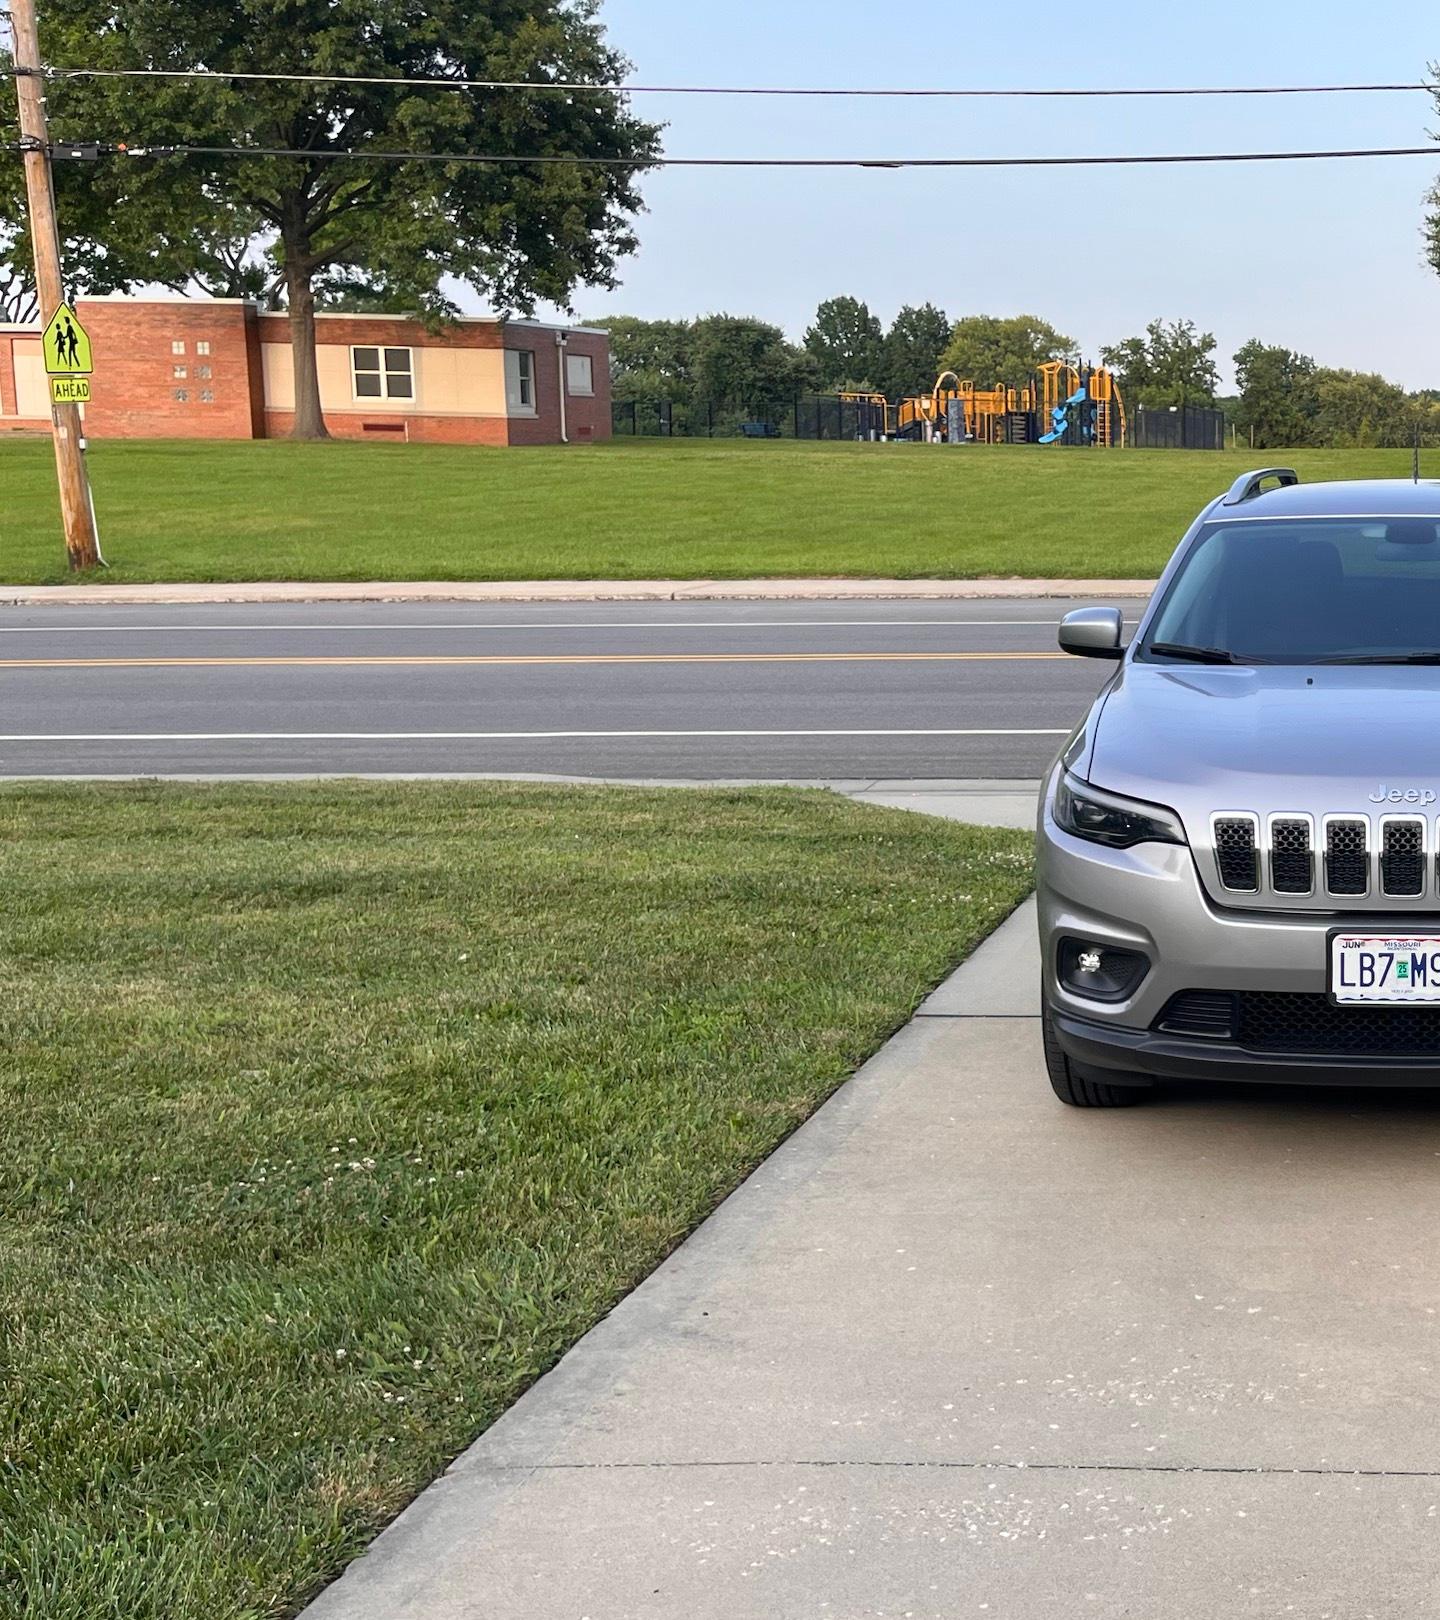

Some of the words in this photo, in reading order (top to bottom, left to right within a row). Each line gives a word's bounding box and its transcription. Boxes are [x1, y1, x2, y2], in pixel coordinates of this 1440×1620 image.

[56, 384, 89, 397] AHEAD
[1368, 784, 1437, 807] Jeep
[1340, 952, 1395, 987] LB7
[1398, 964, 1407, 974] 25
